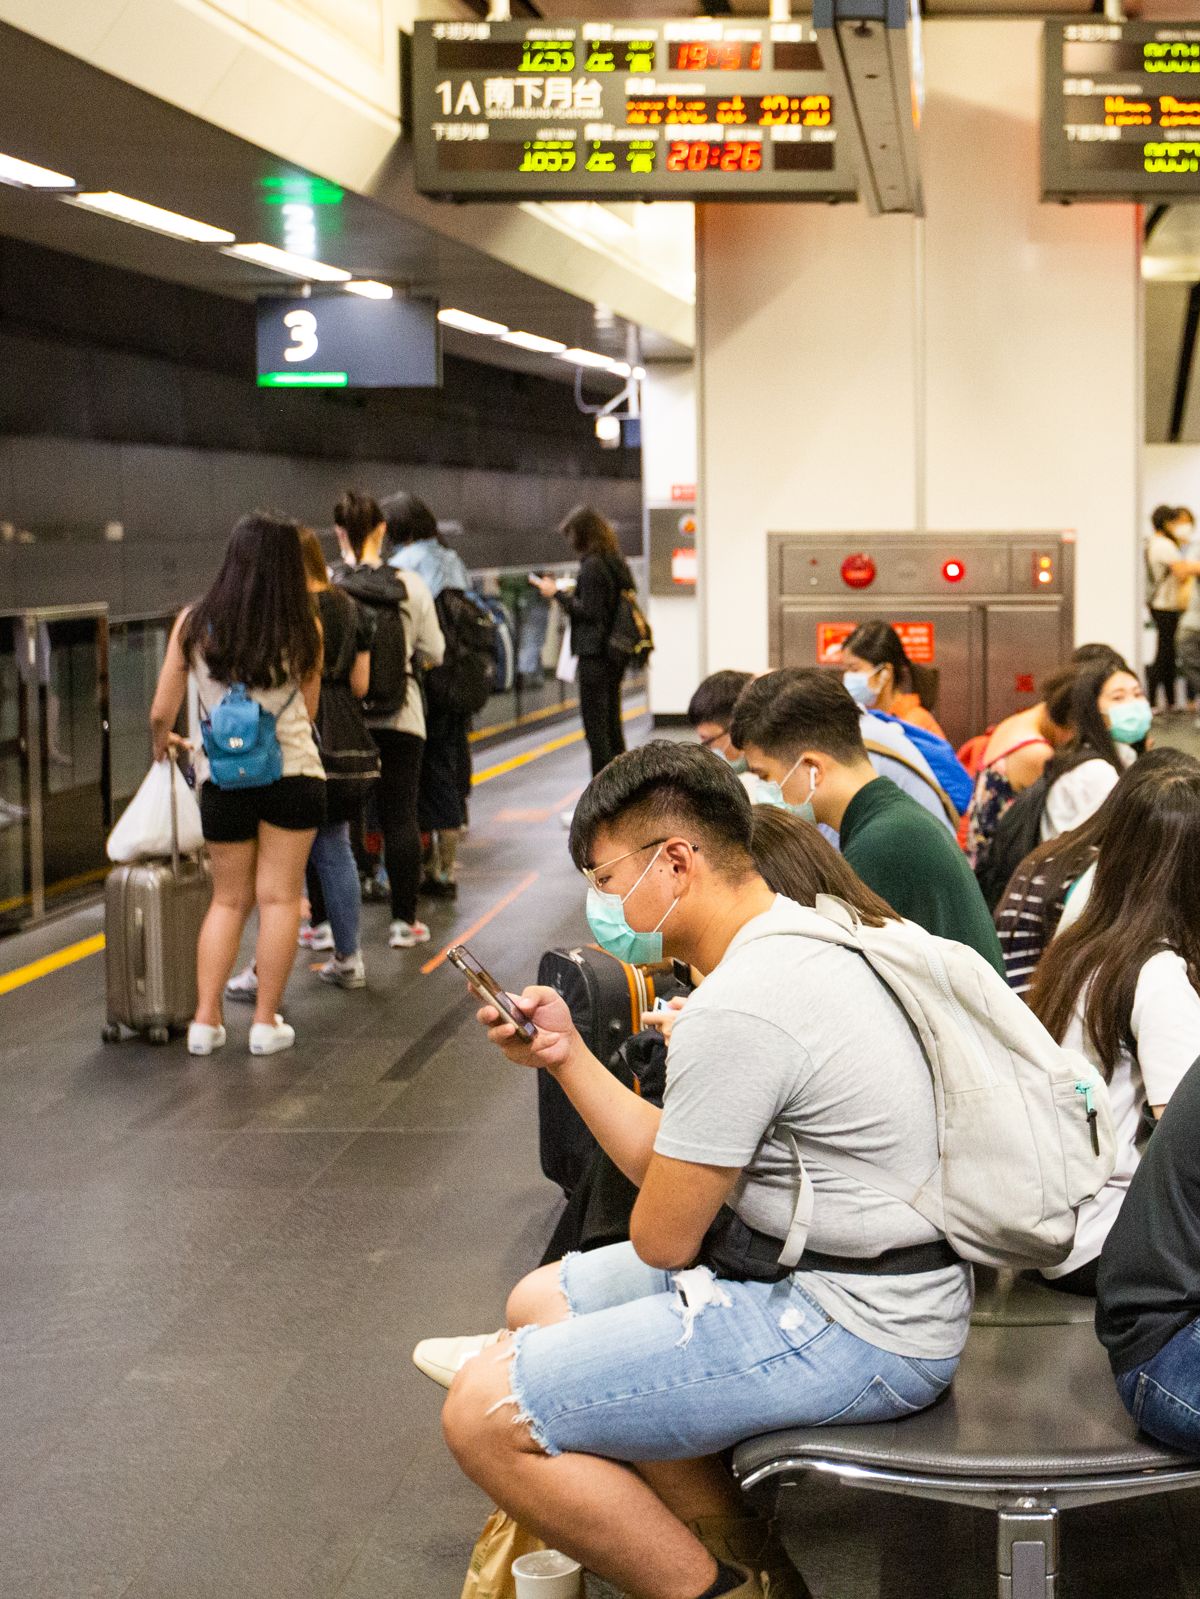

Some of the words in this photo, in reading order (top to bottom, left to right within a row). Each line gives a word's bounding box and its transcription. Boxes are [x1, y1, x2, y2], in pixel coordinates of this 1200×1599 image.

[436, 80, 482, 116] 1A
[666, 141, 762, 172] 20:26
[284, 310, 318, 362] 3
